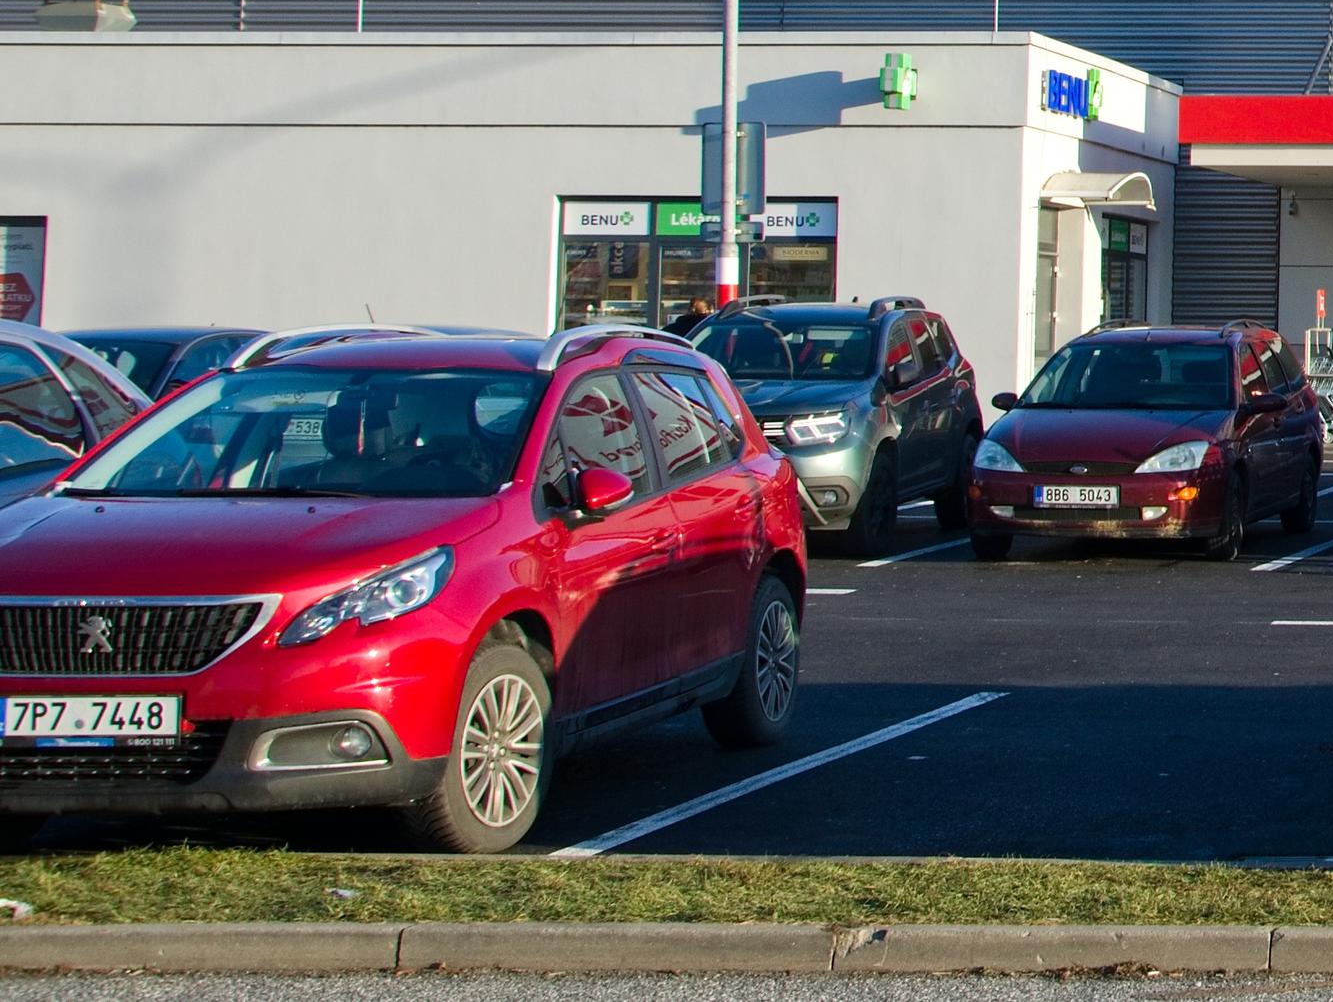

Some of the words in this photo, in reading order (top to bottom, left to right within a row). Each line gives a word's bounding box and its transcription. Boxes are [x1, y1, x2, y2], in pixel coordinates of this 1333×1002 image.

[1047, 70, 1089, 117] BENU
[581, 214, 619, 226] BENU
[766, 215, 805, 227] BENU
[1046, 488, 1069, 502] 8B6
[1079, 488, 1111, 502] 5043
[13, 701, 68, 732] 7P7
[91, 701, 164, 731] 7448
[134, 737, 151, 746] 800
